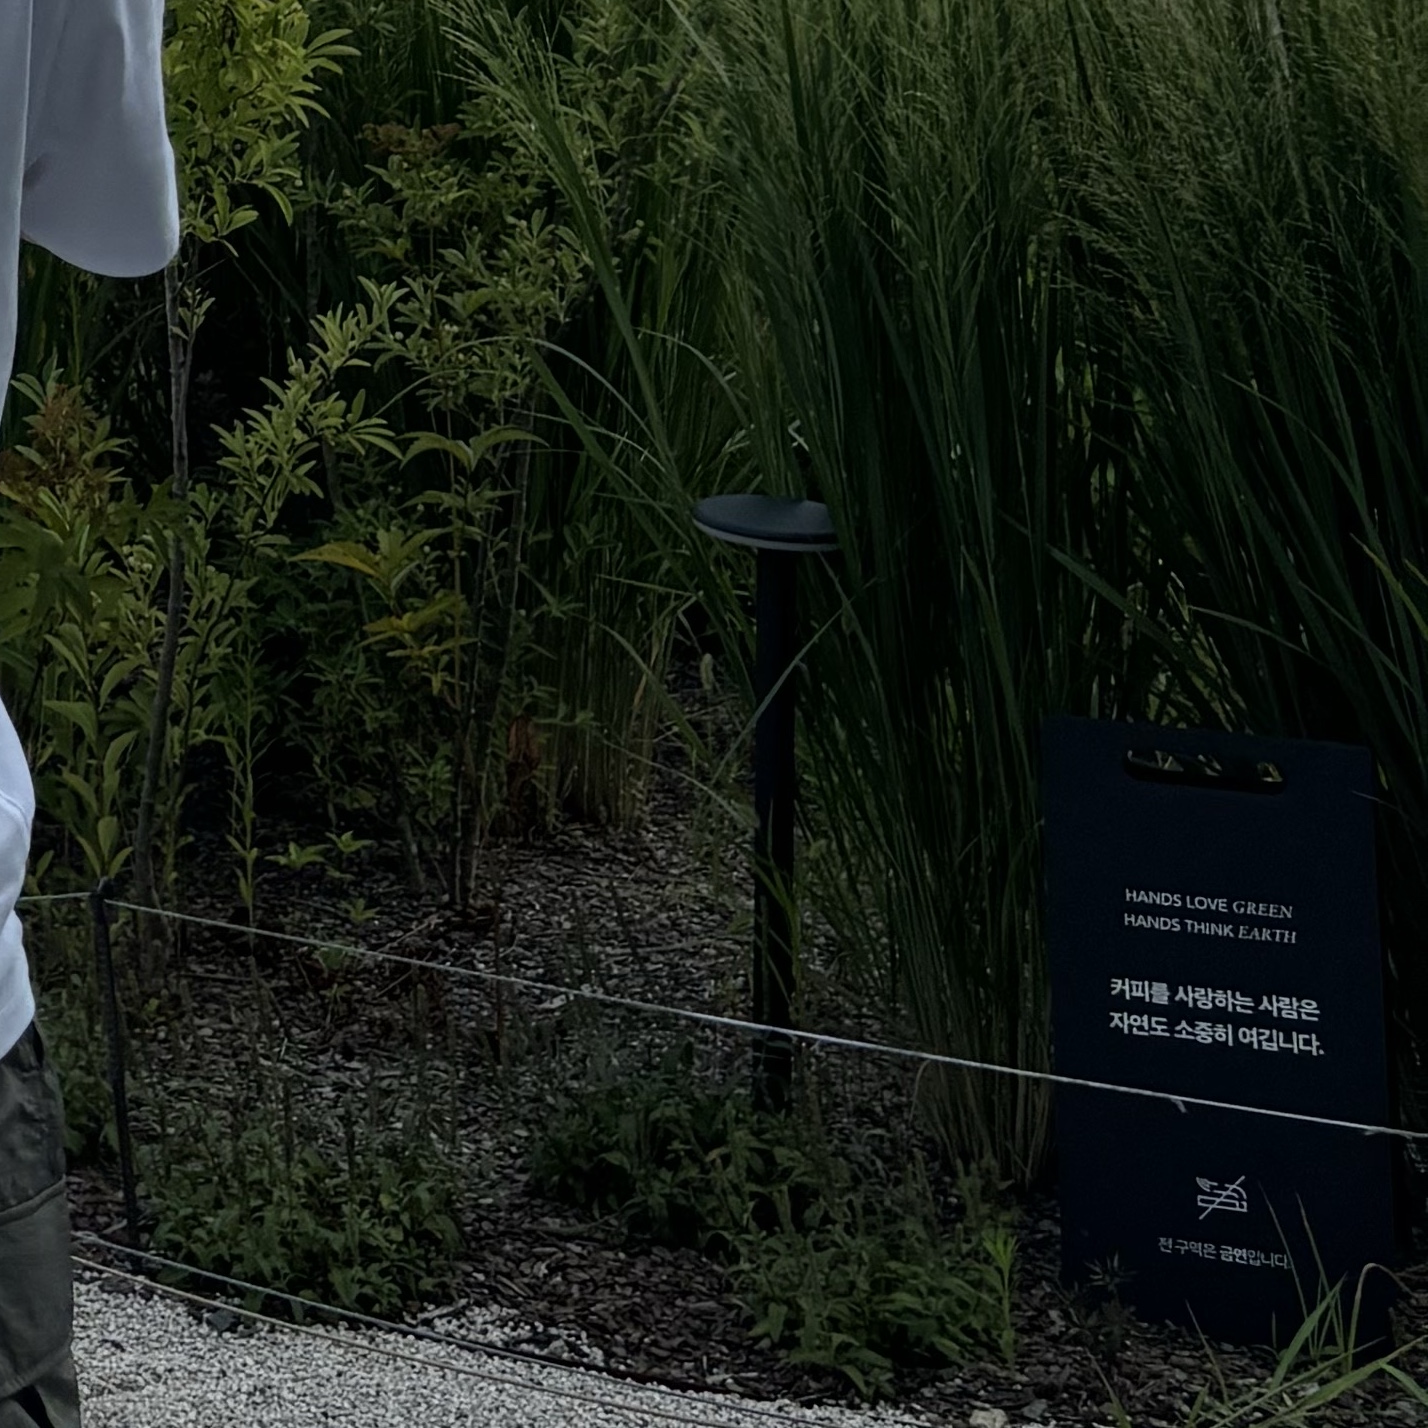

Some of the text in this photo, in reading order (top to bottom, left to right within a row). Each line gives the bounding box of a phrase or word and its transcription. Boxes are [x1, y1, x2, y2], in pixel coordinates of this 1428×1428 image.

[1125, 888, 1293, 919] HANDS LOVE GREEN
[1124, 913, 1296, 944] HANDS THINK EARTH
[1110, 978, 1320, 1021] 커피를 사랑하는 사람은
[1109, 1011, 1325, 1056] 자연도 소중히 여깁니다.
